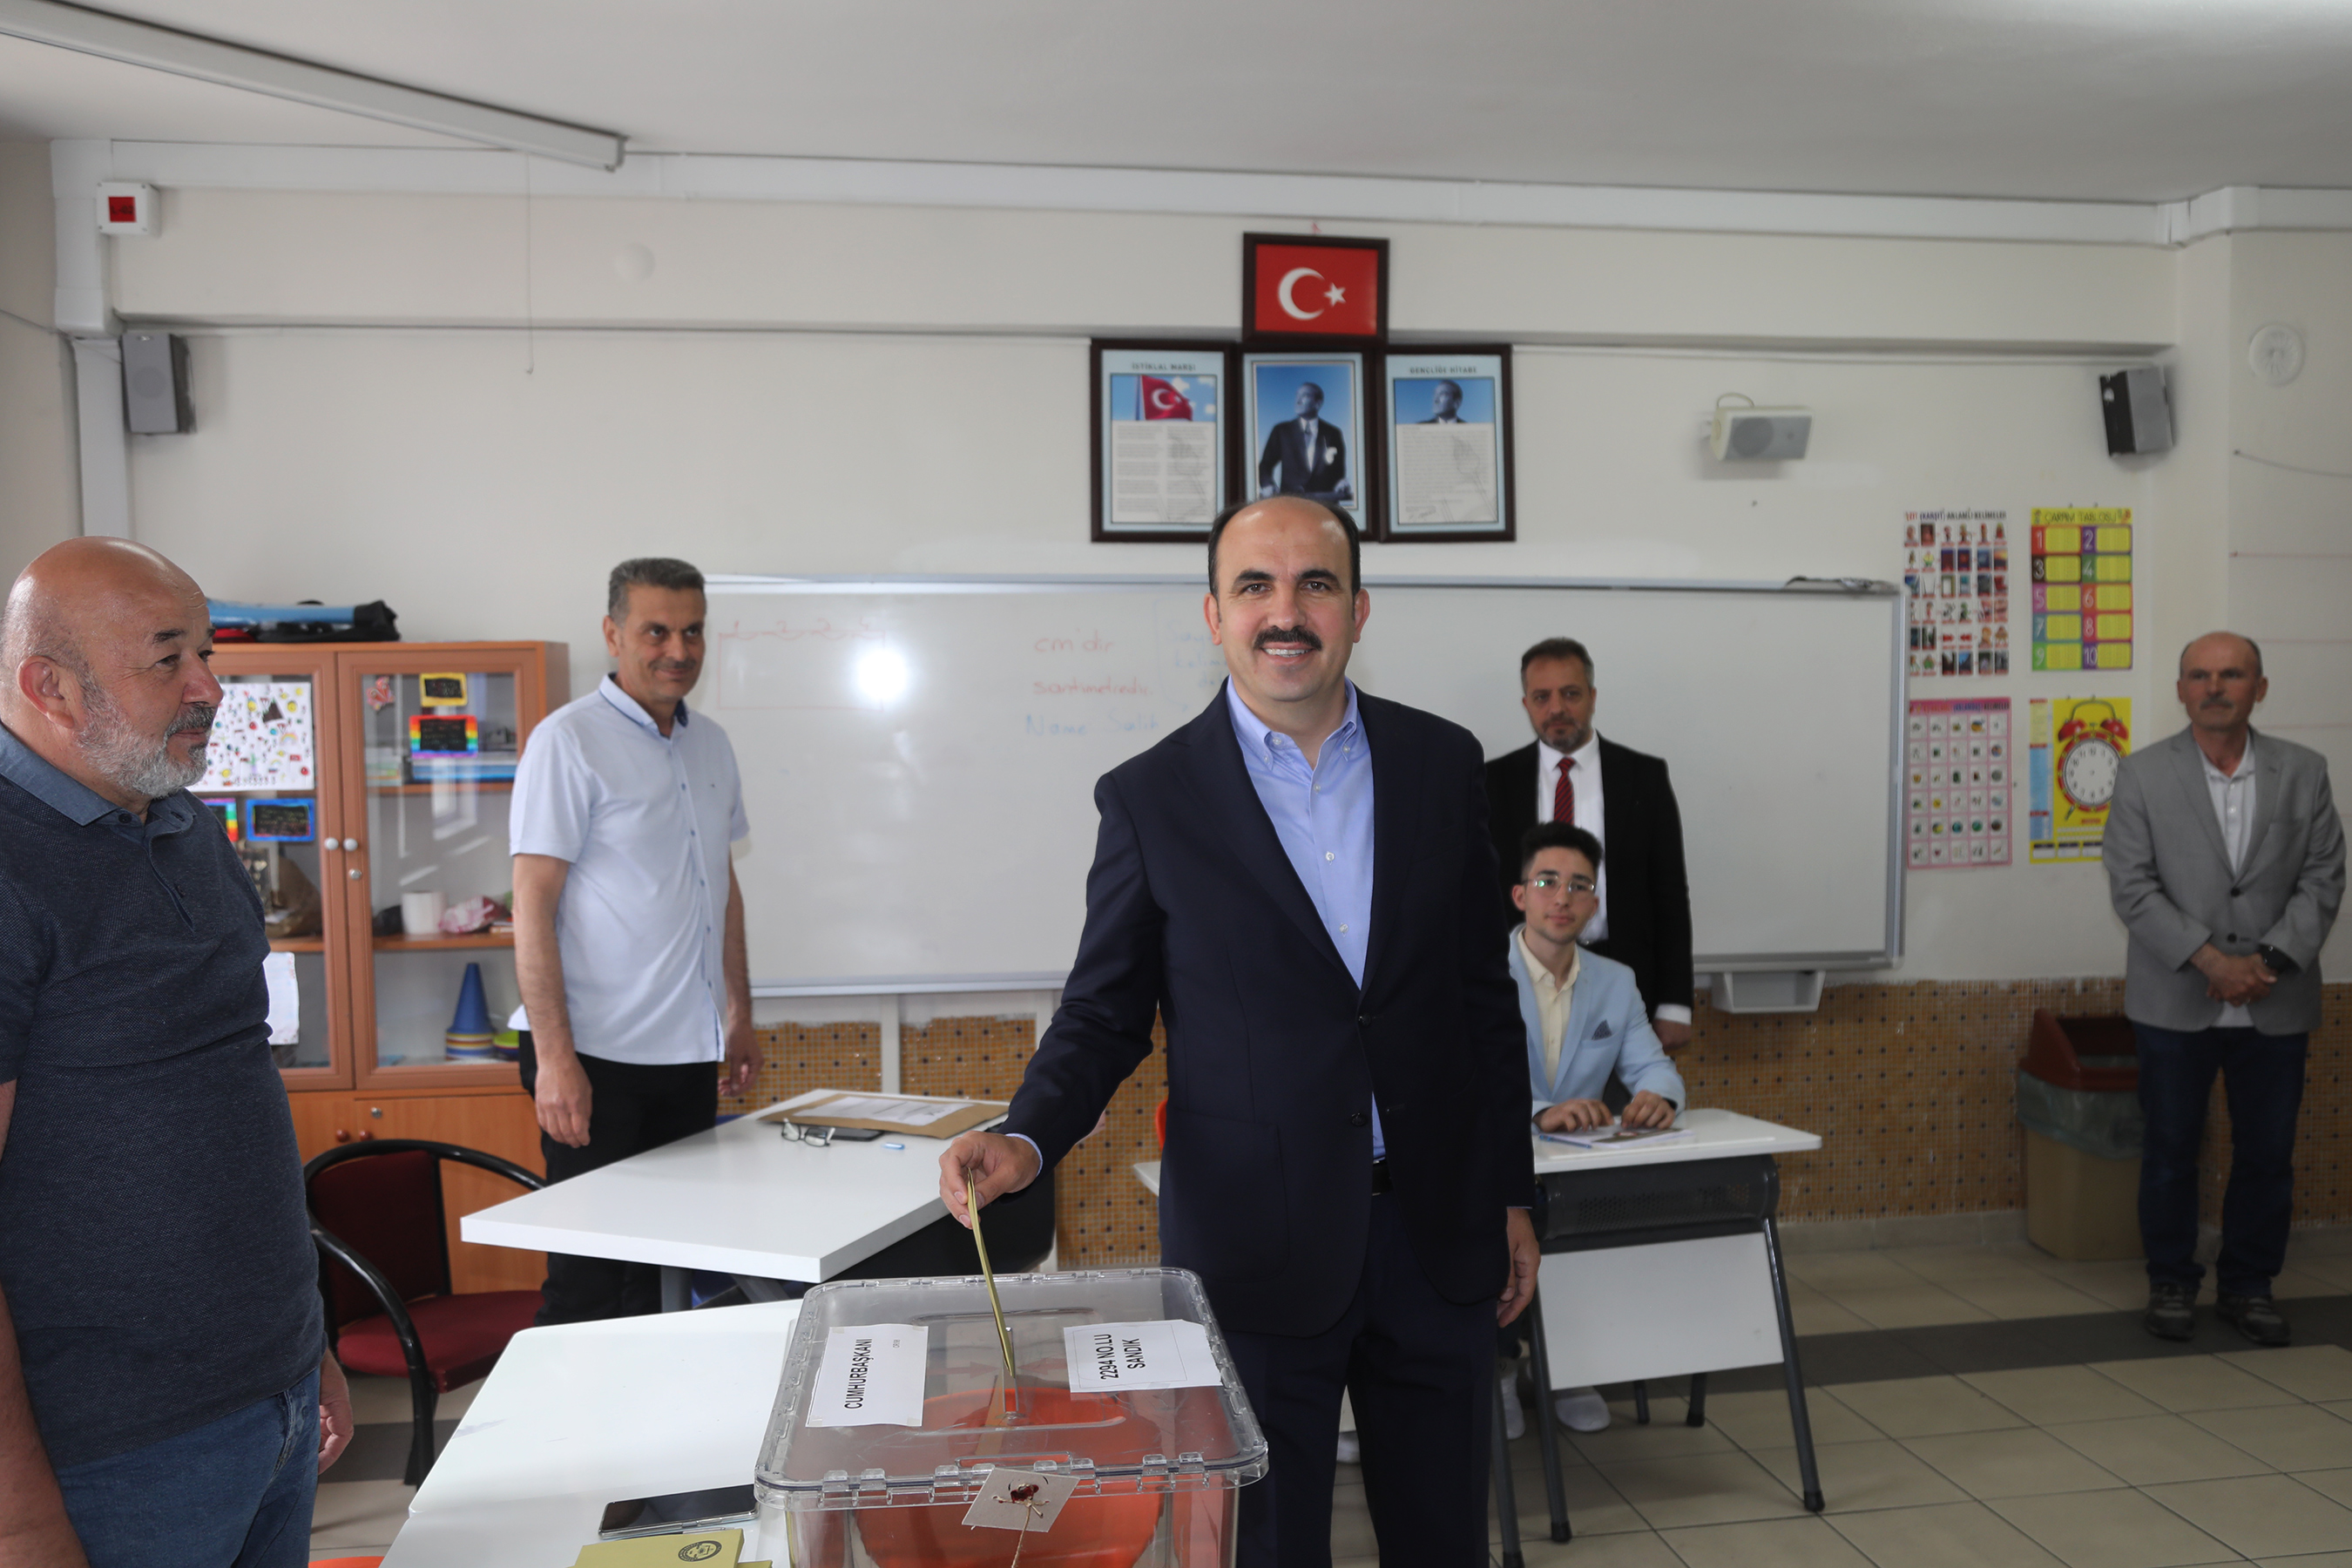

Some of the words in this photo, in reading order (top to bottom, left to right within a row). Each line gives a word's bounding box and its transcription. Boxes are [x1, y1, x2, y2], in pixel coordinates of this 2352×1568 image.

[2037, 530, 2043, 550] 1
[2085, 529, 2094, 551] 2
[2034, 558, 2044, 579] 3
[2083, 560, 2092, 578] 4
[2035, 587, 2044, 609] 5
[2084, 588, 2094, 608] 6
[2037, 617, 2044, 638] 7
[2084, 617, 2094, 637] 8
[2036, 647, 2044, 666] 9
[2084, 646, 2098, 666] 10
[1093, 1334, 1116, 1359] NO.LU
[1122, 1338, 1146, 1369] SANDIK
[843, 1338, 875, 1409] CUMHURBAŞKANI
[1098, 1360, 1119, 1380] 2294
